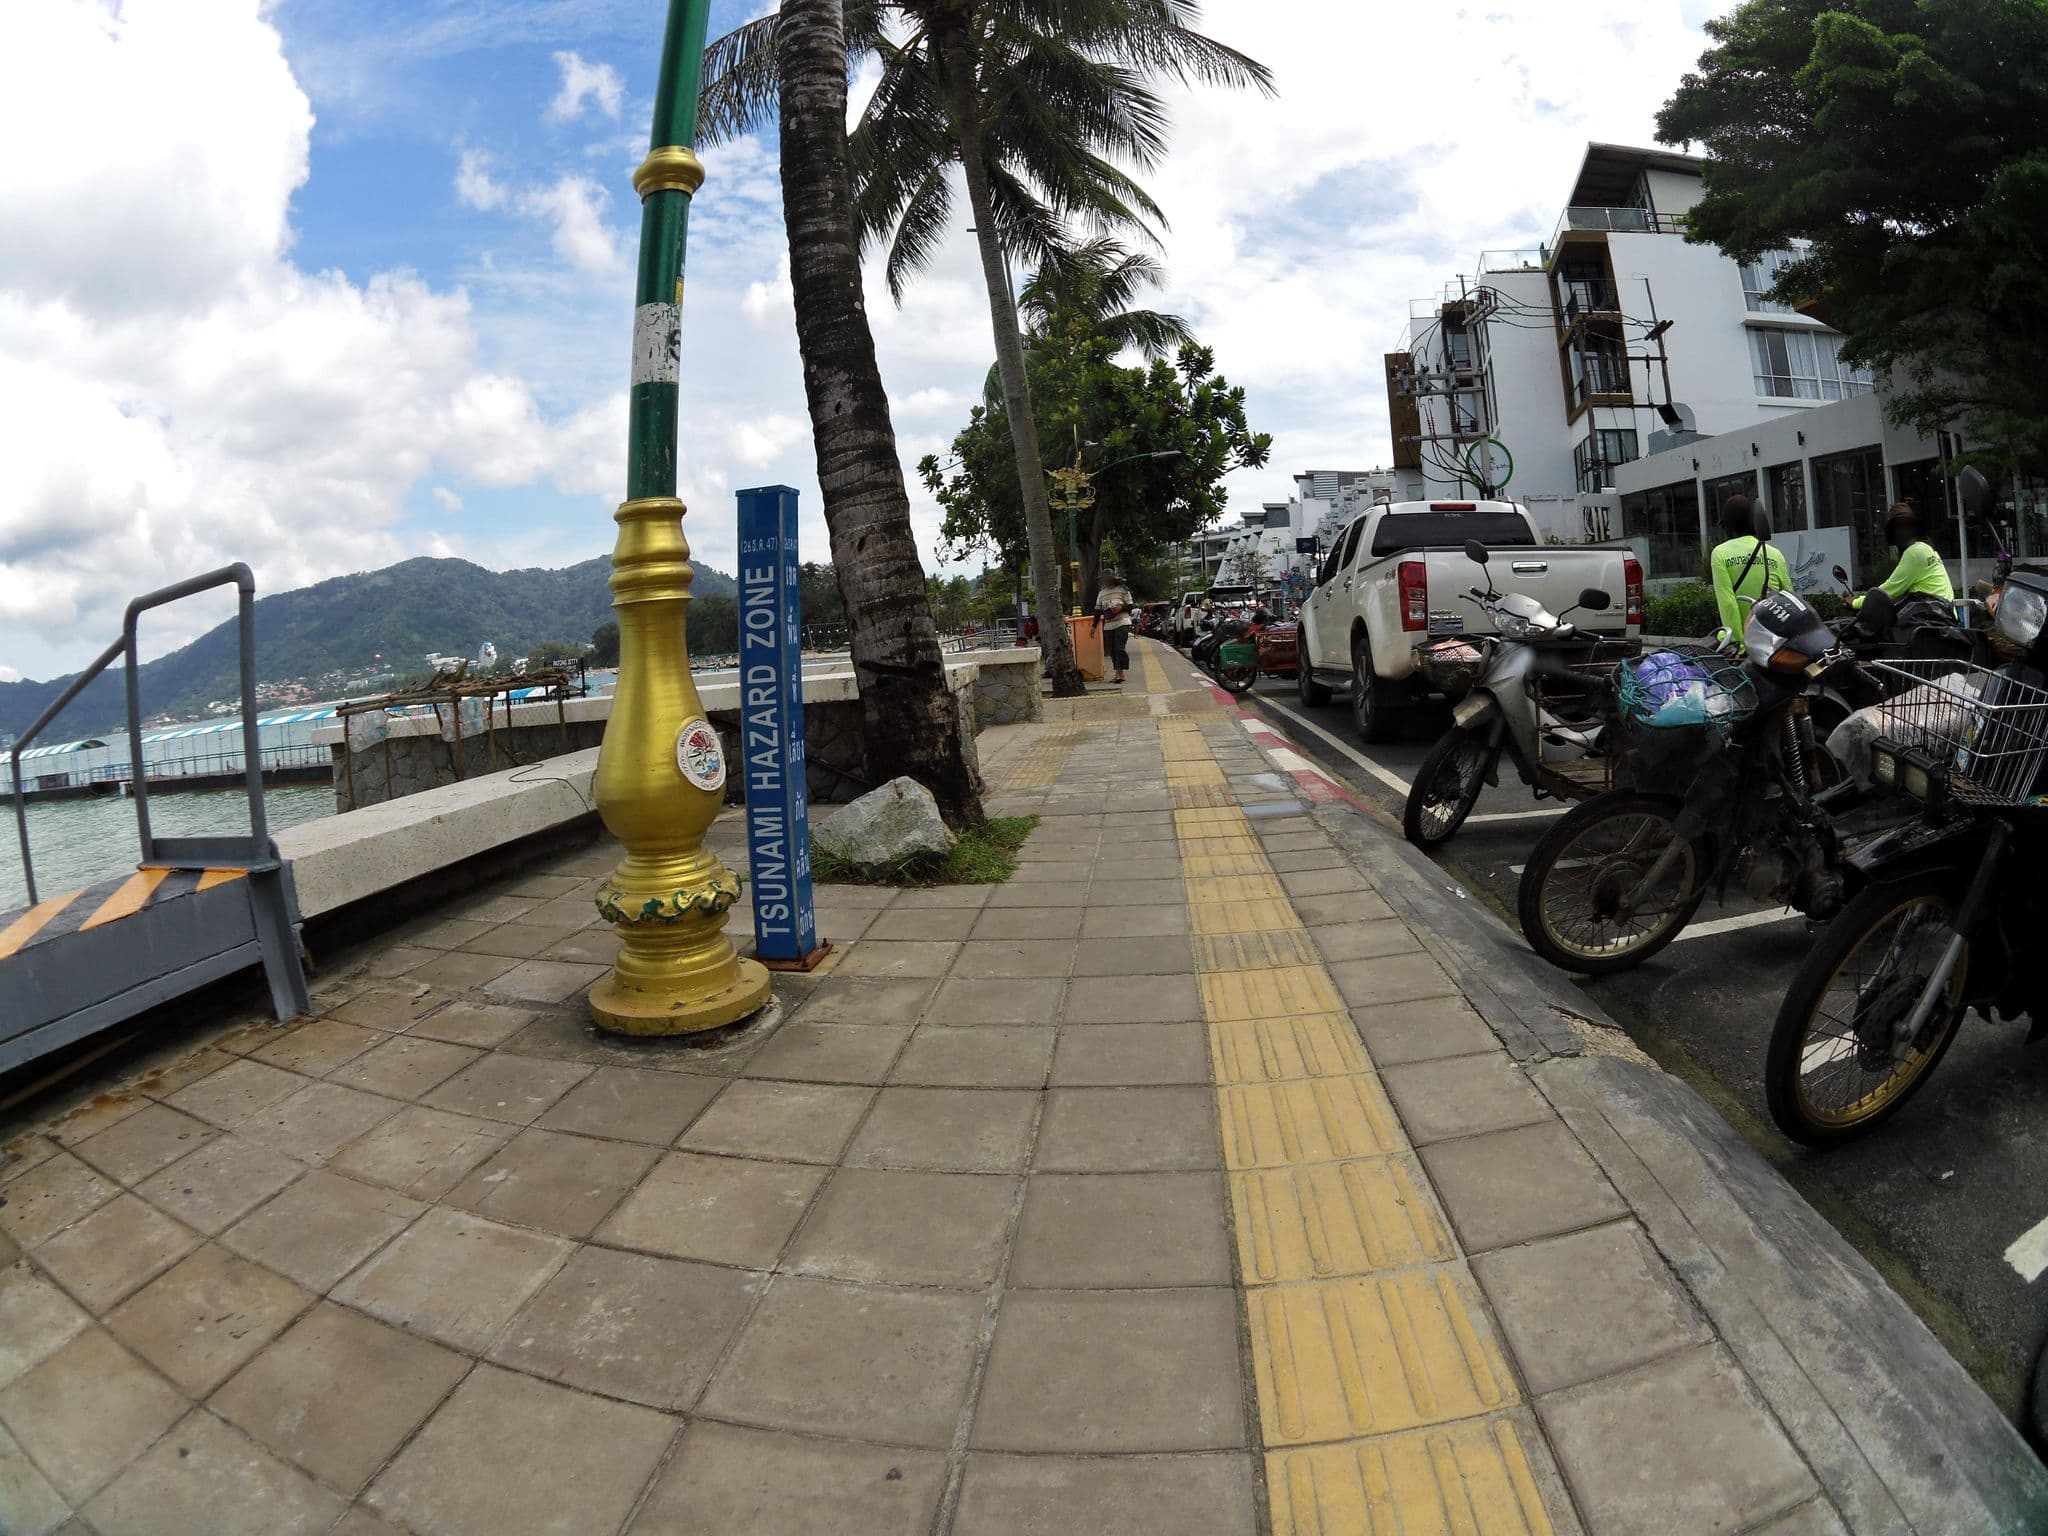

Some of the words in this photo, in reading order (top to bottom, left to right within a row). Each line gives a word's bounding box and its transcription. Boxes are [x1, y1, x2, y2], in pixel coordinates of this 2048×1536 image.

[745, 565, 776, 649] ZONE
[747, 665, 781, 790] HAZARD
[753, 806, 791, 938] TSUNAMI
